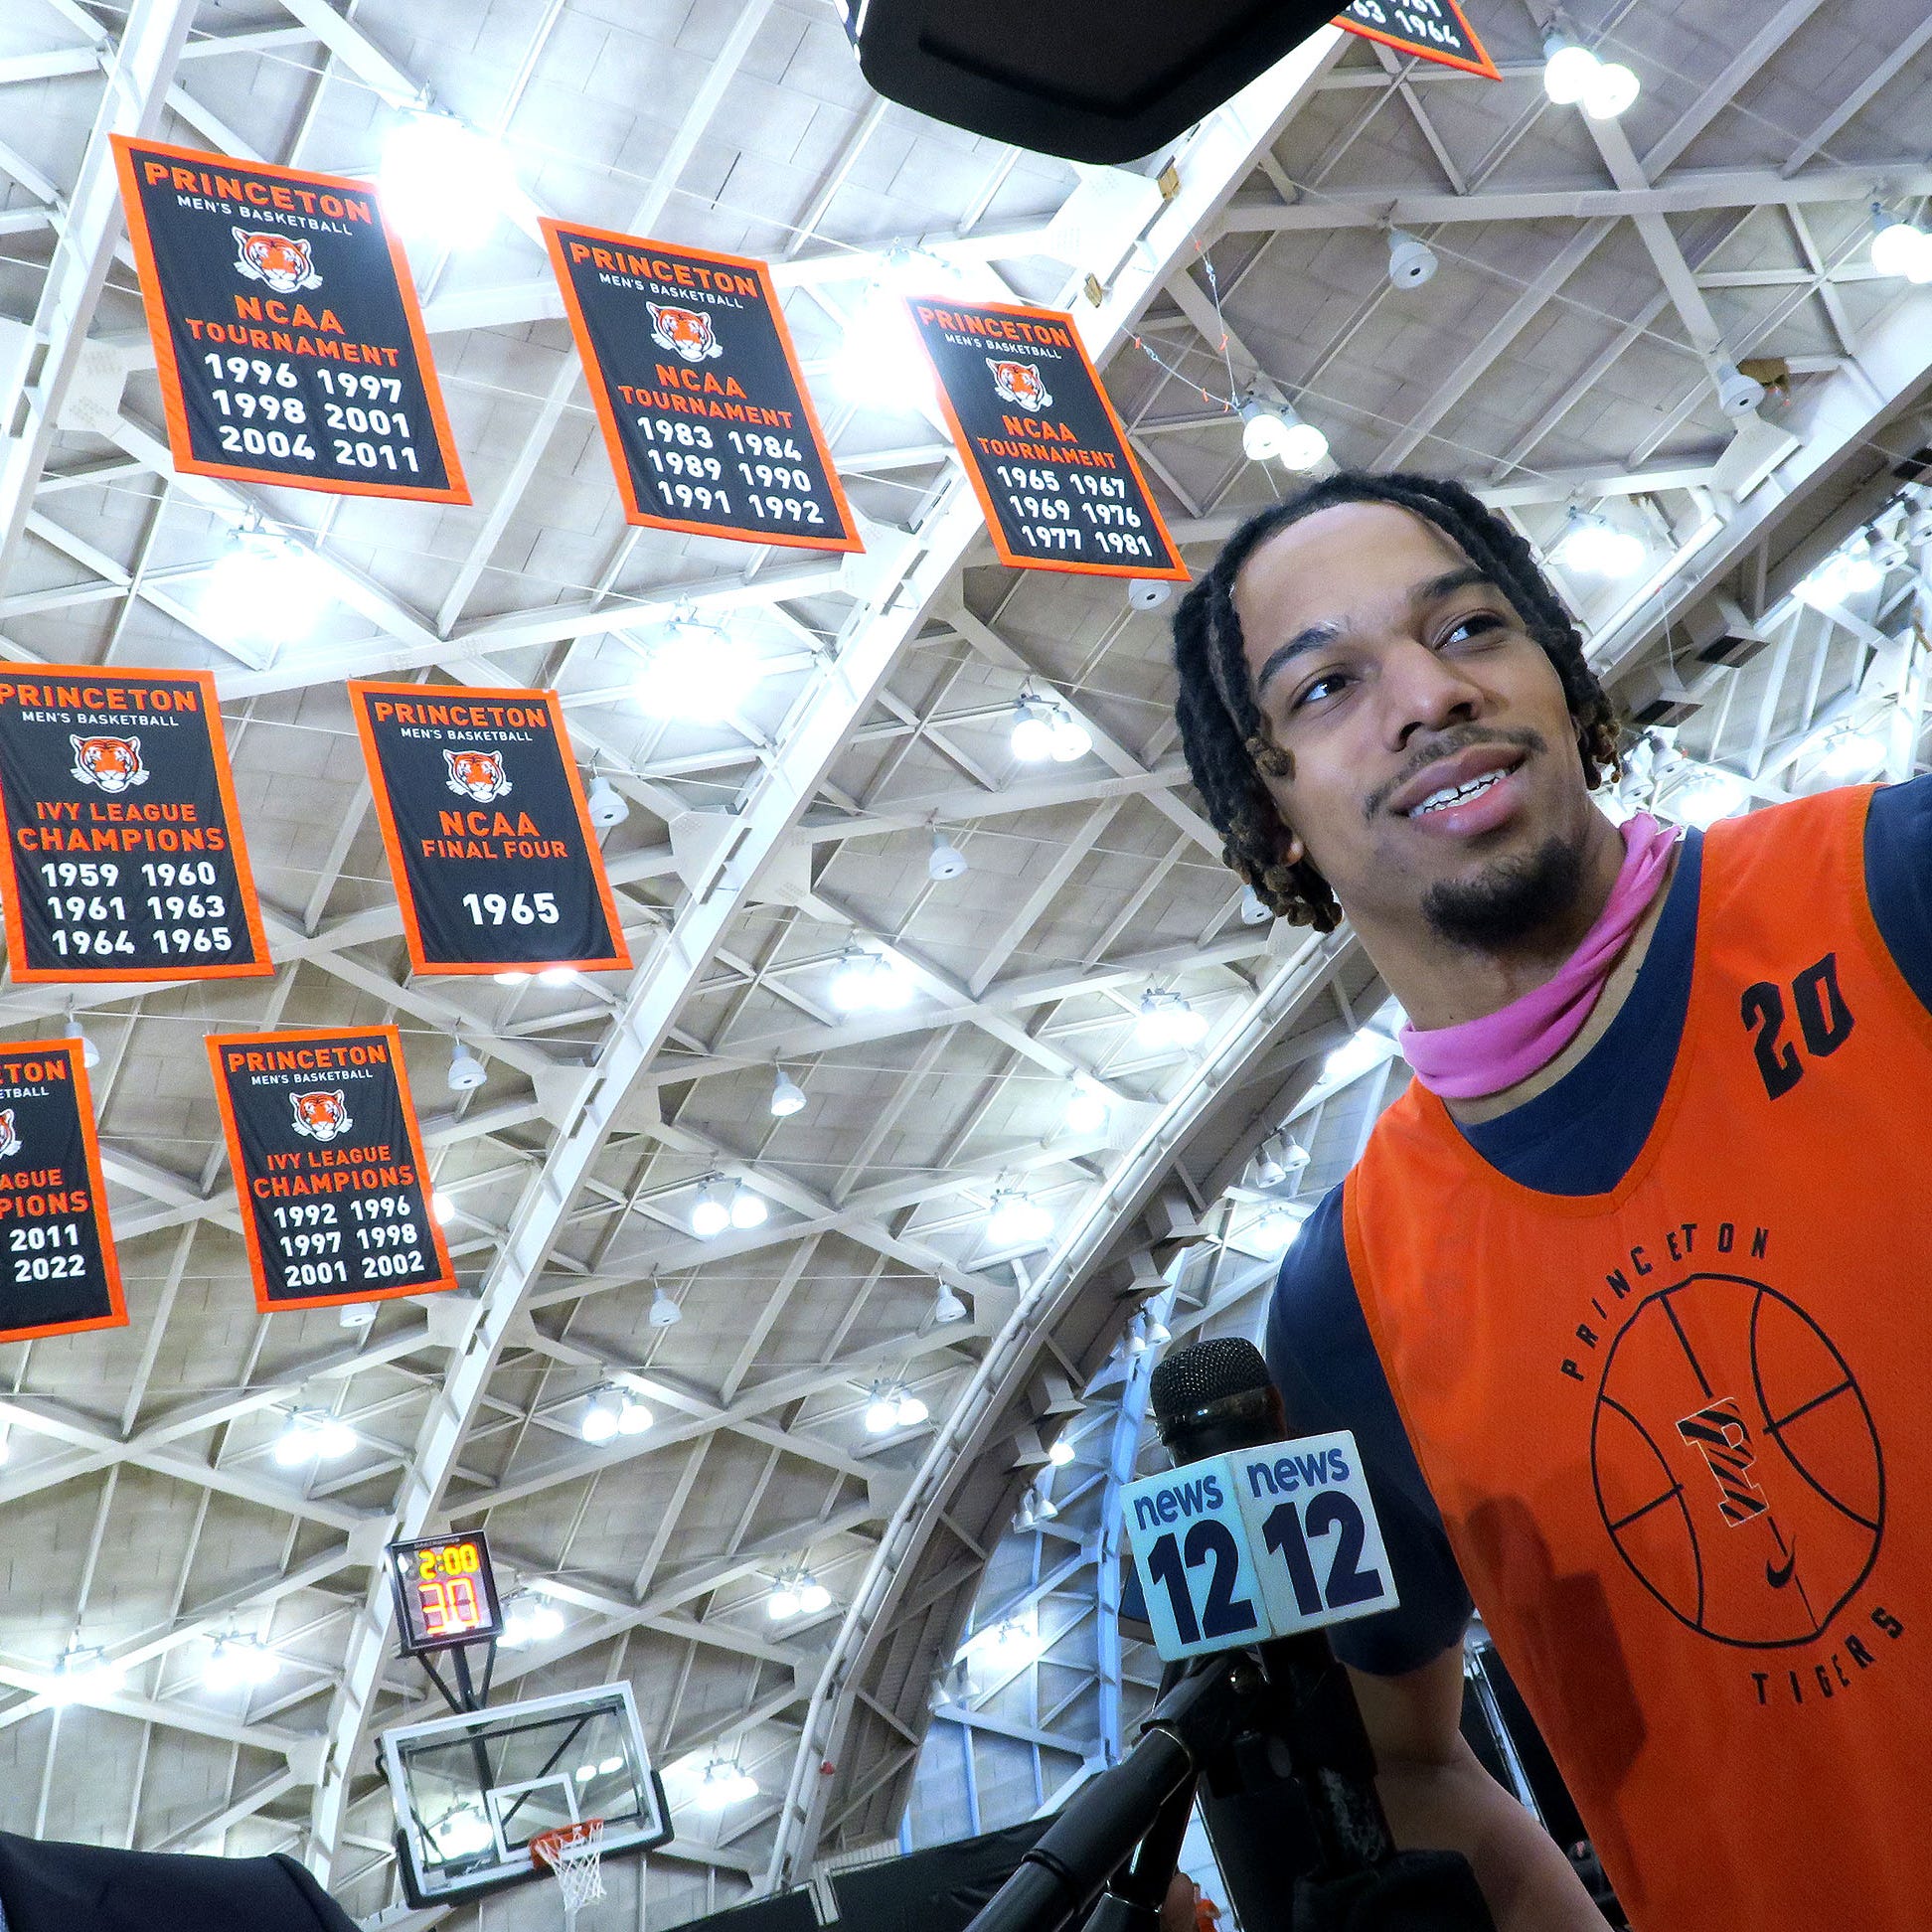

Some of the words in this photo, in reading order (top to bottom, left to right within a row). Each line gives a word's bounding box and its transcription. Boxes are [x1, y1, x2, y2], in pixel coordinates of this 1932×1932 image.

[1395, 10, 1460, 48] 1964
[144, 161, 372, 224] PRINCETON
[177, 196, 232, 215] MEN'S
[240, 206, 353, 236] BASKETBALL
[568, 242, 758, 298] PRINCETON
[599, 273, 644, 290] MEN'S
[649, 282, 743, 309] BASKETBALL
[234, 294, 345, 335] NCAA
[916, 306, 1072, 349] PRINCETON
[186, 319, 399, 367] TOURNAMENT
[944, 333, 982, 348] MEN'S
[986, 340, 1062, 359] BASKETBALL
[204, 353, 298, 389] 1996
[317, 368, 402, 403] 1997
[654, 364, 747, 399] NCAA
[212, 390, 306, 423] 1998
[324, 403, 410, 438] 2001
[618, 386, 793, 429] TOURNAMENT
[637, 416, 714, 449] 1983
[728, 431, 802, 461] 1984
[1002, 415, 1078, 444] NCAA
[219, 425, 316, 461] 2004
[334, 440, 419, 472] 2011
[977, 436, 1116, 469] TOURNAMENT
[648, 449, 721, 481] 1989
[738, 463, 812, 493] 1990
[997, 465, 1060, 492] 1965
[1069, 473, 1125, 499] 1967
[658, 480, 731, 514] 1991
[748, 494, 825, 524] 1992
[1010, 495, 1069, 521] 1969
[1081, 502, 1141, 528] 1976
[1022, 525, 1081, 550] 1977
[1095, 531, 1153, 557] 1981
[0, 684, 199, 712] PRINCETON
[374, 702, 547, 727] PRINCETON
[23, 712, 71, 724] MEN'S
[78, 713, 179, 726] BASKETBALL
[401, 727, 441, 739] MEN'S
[447, 729, 533, 741] BASKETBALL
[37, 802, 80, 821] IVY
[91, 803, 199, 822] LEAGUE
[438, 811, 541, 837] NCAA
[17, 828, 226, 852] CHAMPIONS
[421, 839, 497, 859] FINAL
[505, 841, 568, 859] FOUR
[41, 862, 119, 887] 1959
[141, 861, 216, 886] 1960
[48, 896, 125, 921] 1961
[147, 895, 226, 920] 1963
[462, 892, 560, 924] 1965
[52, 929, 135, 955] 1964
[152, 927, 232, 954] 1965
[1741, 952, 1855, 1101] 20
[0, 1059, 67, 1084] TON
[228, 1045, 387, 1073] PRINCETON
[251, 1074, 288, 1085] MEN'S
[293, 1068, 373, 1083] BASKETBALL
[266, 1153, 301, 1171] IVY
[308, 1145, 391, 1168] LEAGUE
[253, 1165, 415, 1199] CHAMPIONS
[273, 1203, 338, 1228] 1992
[350, 1196, 410, 1221] 1996
[10, 1223, 79, 1252] 2011
[279, 1231, 342, 1257] 1997
[357, 1223, 417, 1250] 1998
[14, 1254, 85, 1282] 2022
[285, 1261, 347, 1287] 2001
[361, 1251, 424, 1279] 2002
[1560, 1222, 1768, 1381] PRINCETON
[1246, 1448, 1350, 1498] news
[1133, 1475, 1224, 1530] news
[418, 1542, 479, 1580] 2:00
[1262, 1491, 1384, 1616] 12
[1147, 1519, 1258, 1645] 12
[417, 1577, 480, 1635] 30
[1751, 1606, 1904, 1704] TIGERS
